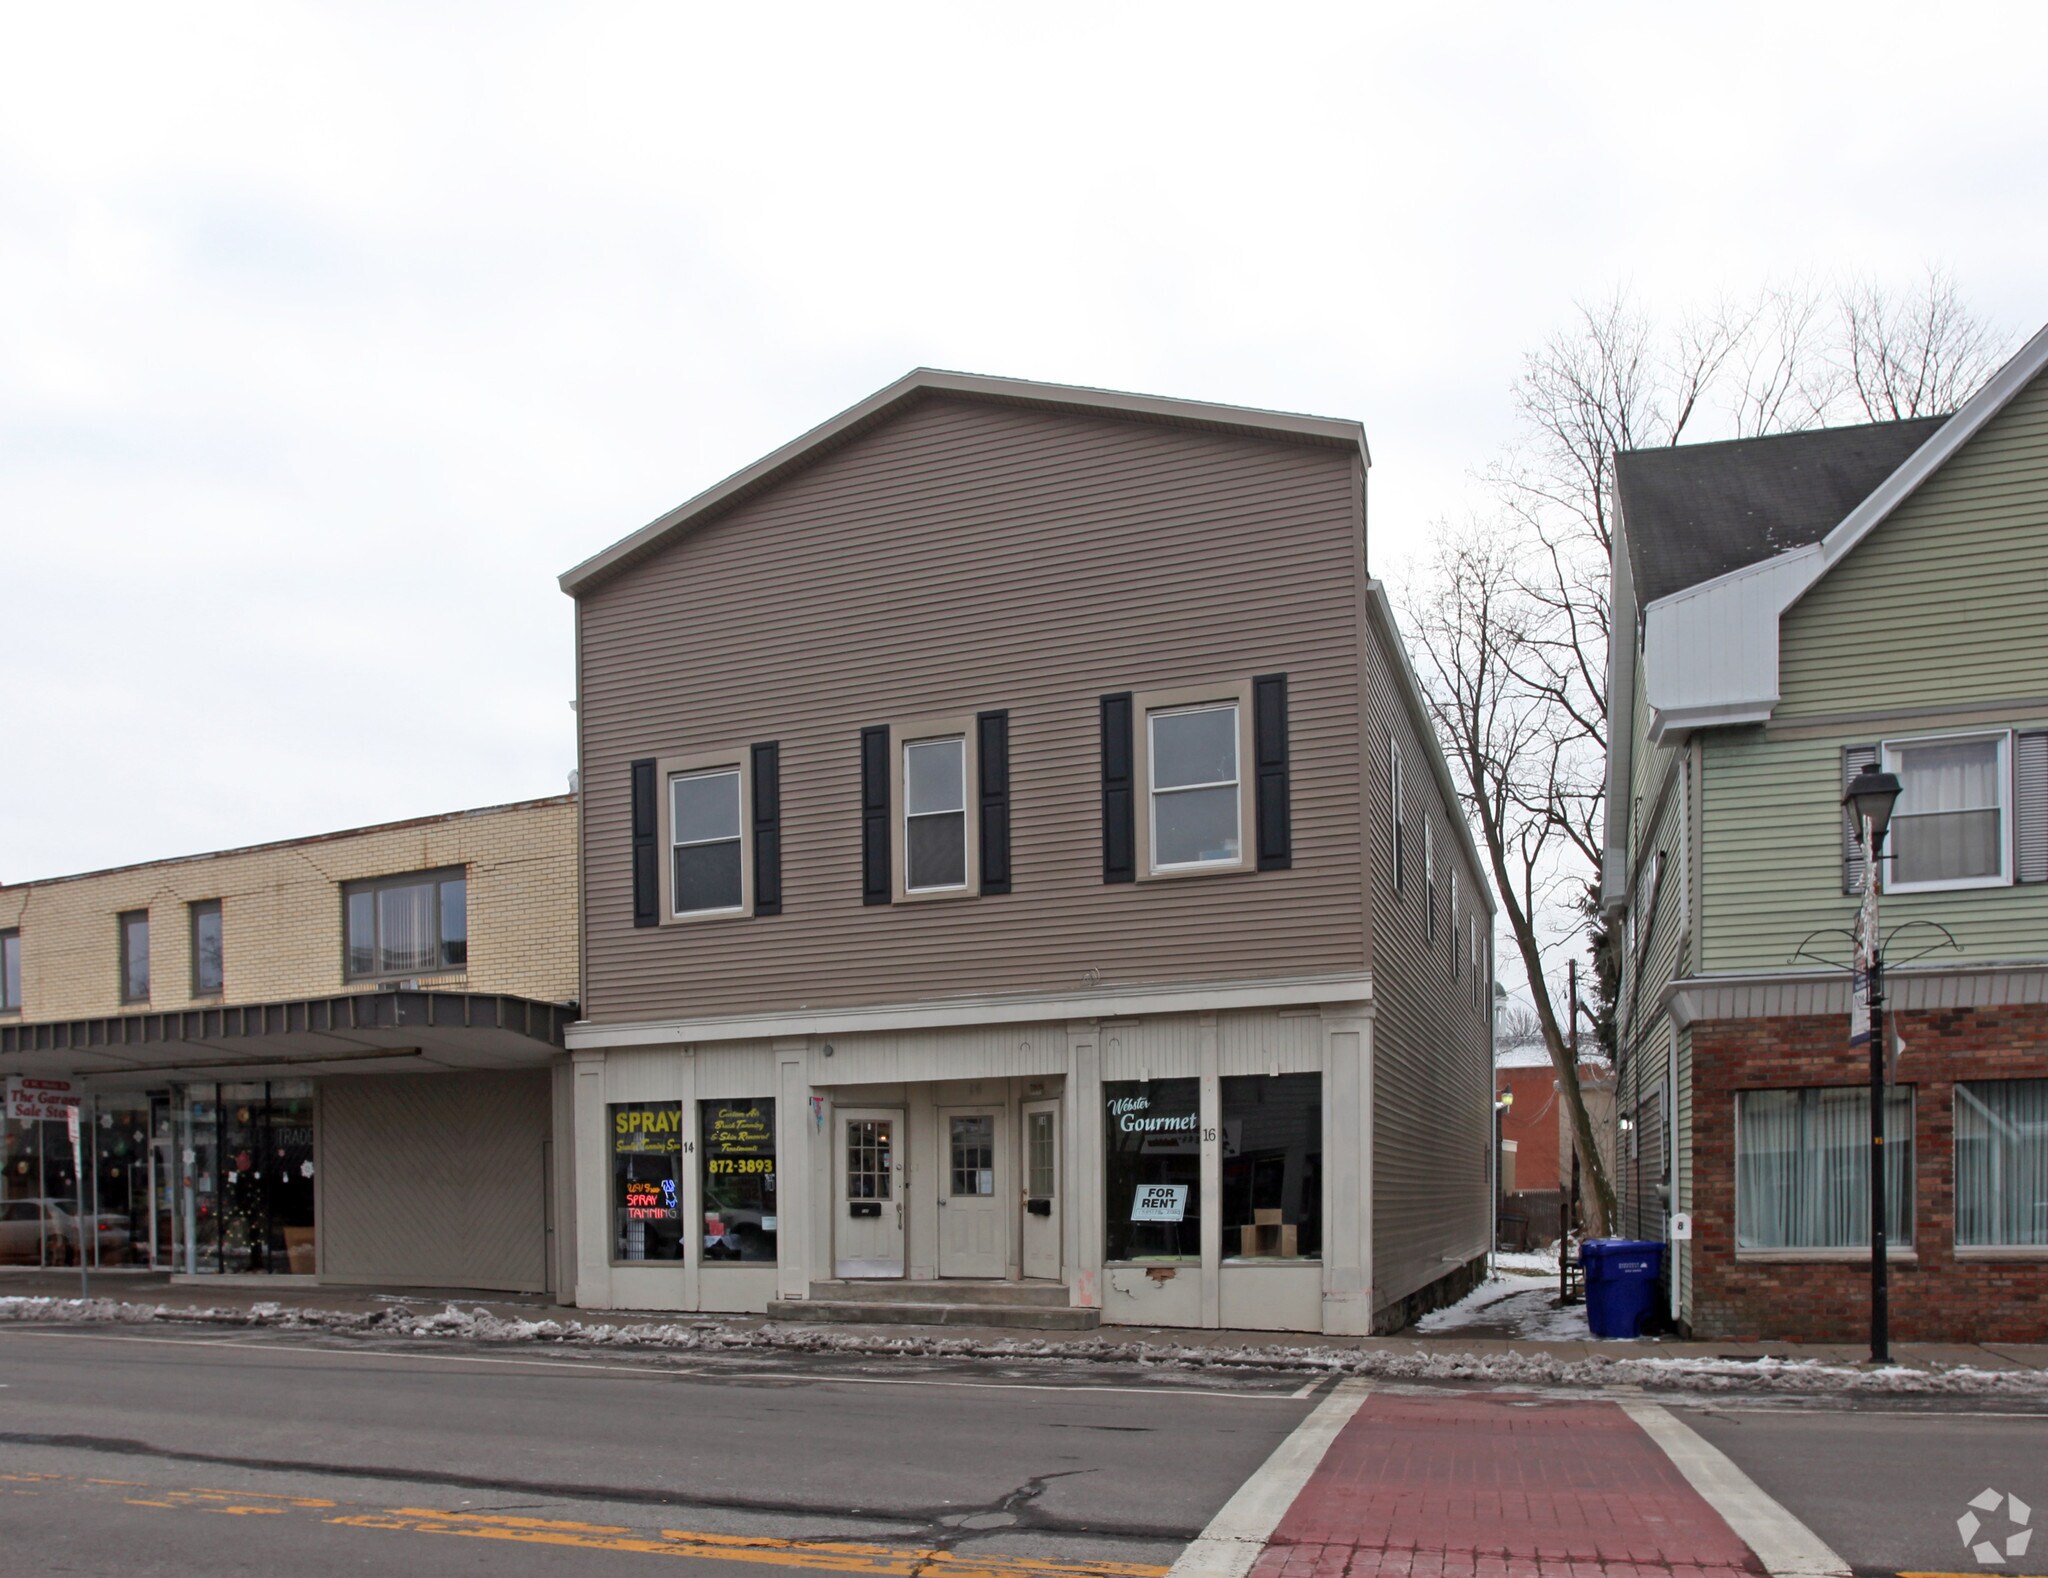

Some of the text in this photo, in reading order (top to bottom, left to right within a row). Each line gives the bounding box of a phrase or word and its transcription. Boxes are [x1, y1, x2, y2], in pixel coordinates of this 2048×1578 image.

[11, 1089, 82, 1106] The Garage
[16, 1103, 42, 1117] Sale
[1107, 1097, 1150, 1116] Webster
[616, 1111, 682, 1134] SPRAY
[736, 1119, 765, 1131] Tanning
[1120, 1112, 1198, 1132] Gourmet
[1203, 1128, 1217, 1142] 16
[684, 1142, 695, 1153] 14
[709, 1159, 773, 1173] 872-3893
[1147, 1188, 1174, 1198] FOR
[626, 1194, 658, 1206] SPRAY
[1141, 1198, 1178, 1208] RENT
[628, 1207, 677, 1219] TANNING
[1677, 1221, 1684, 1230] 8
